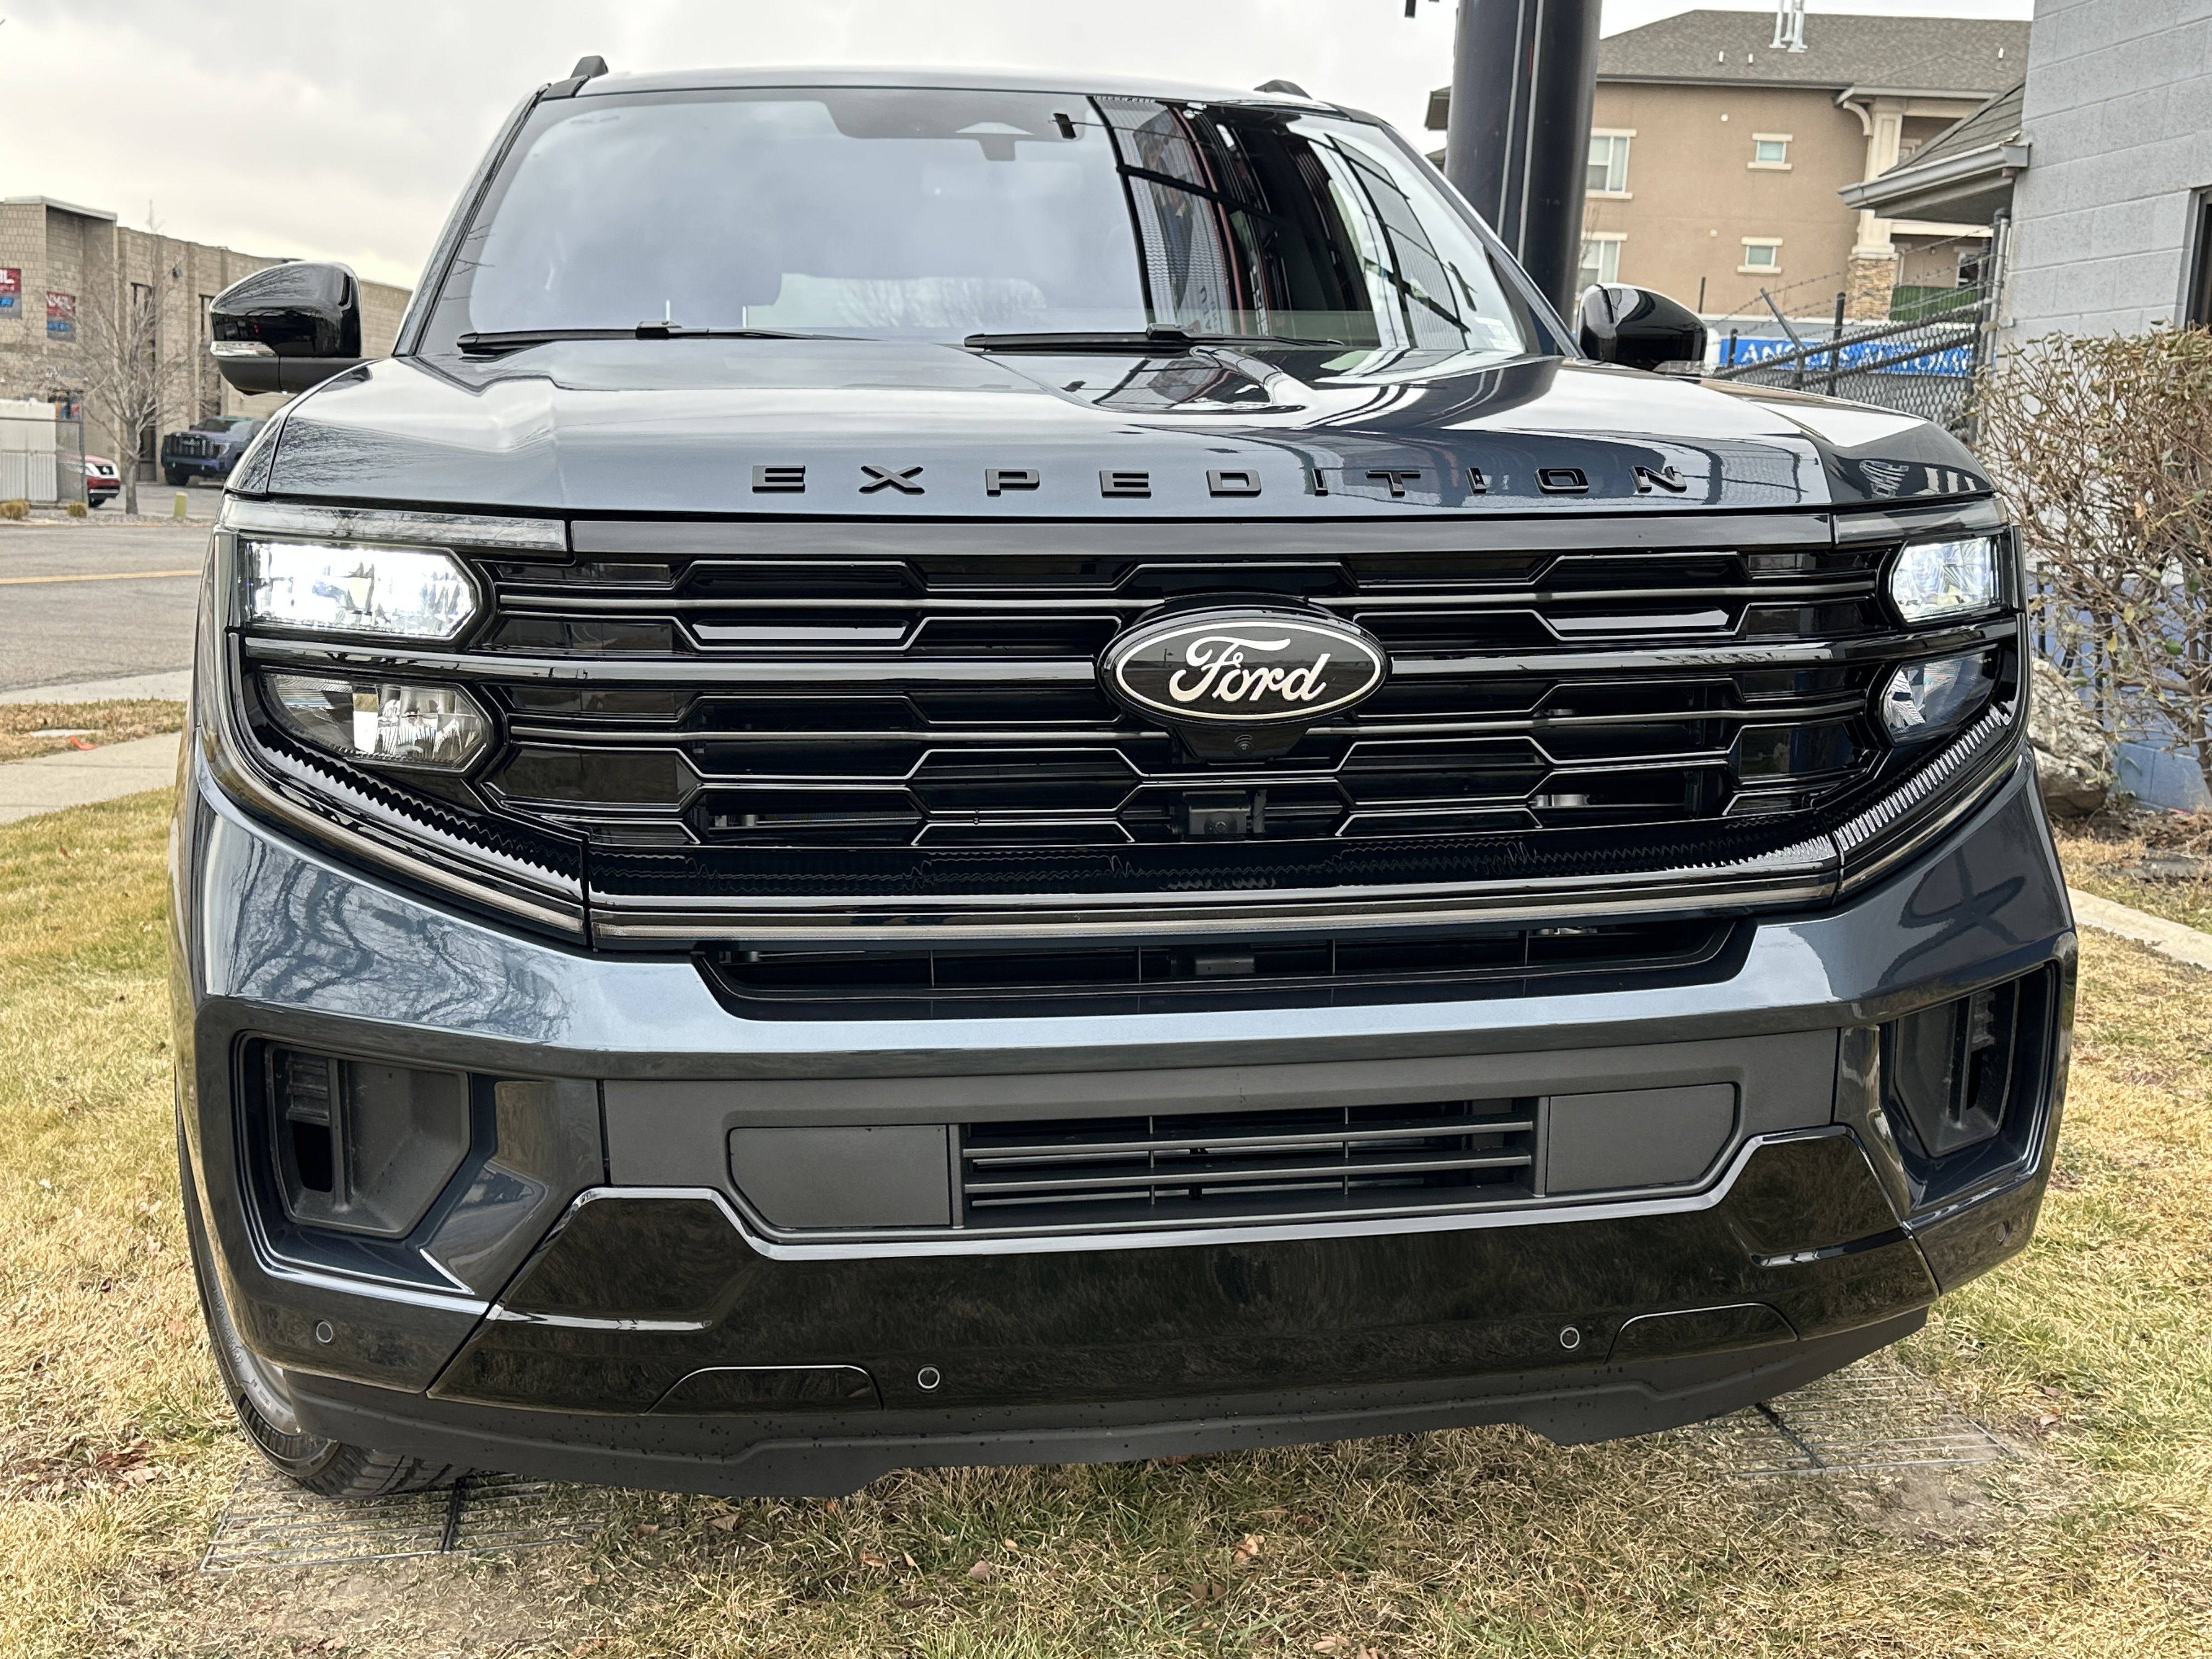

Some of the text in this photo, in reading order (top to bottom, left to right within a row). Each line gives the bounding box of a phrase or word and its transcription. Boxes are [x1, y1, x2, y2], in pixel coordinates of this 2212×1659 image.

[752, 465, 1688, 498] EXPEDITION
[1169, 636, 1331, 702] Ford
[241, 1398, 302, 1457] MICHELIN
